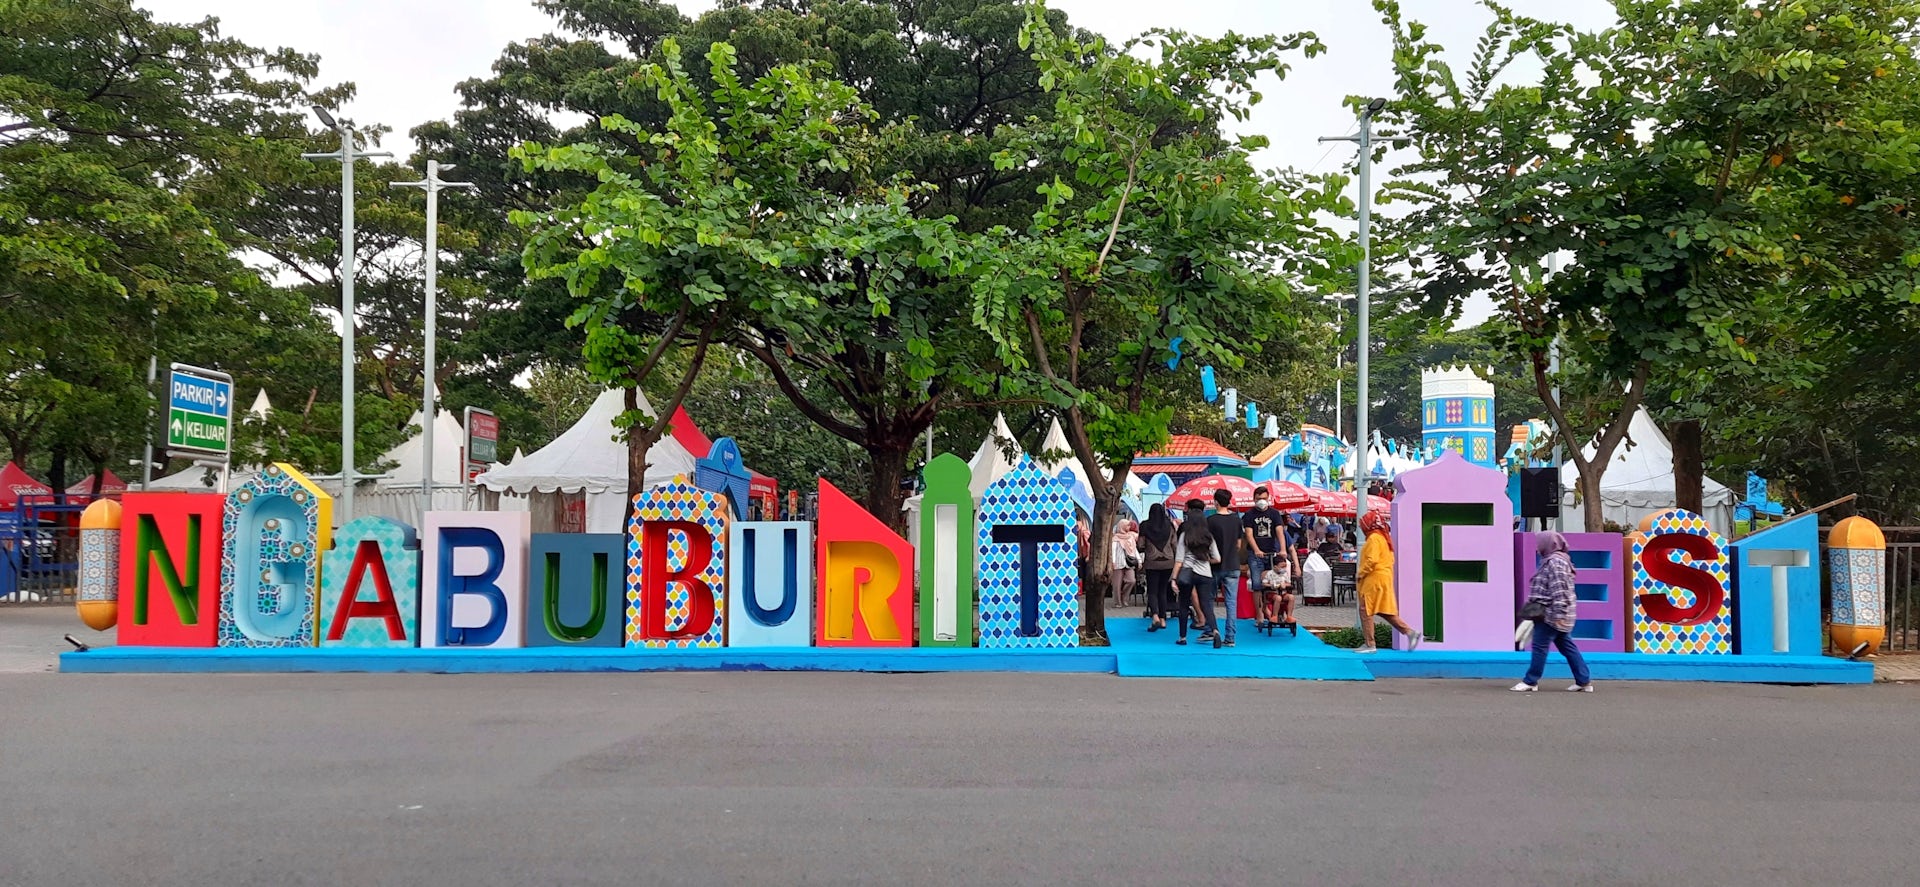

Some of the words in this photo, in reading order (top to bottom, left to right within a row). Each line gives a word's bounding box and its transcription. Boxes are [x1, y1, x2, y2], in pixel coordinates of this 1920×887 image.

[174, 381, 213, 406] PARKIR
[187, 421, 225, 442] KELUAR
[133, 492, 1065, 647] NGABUBURIT
